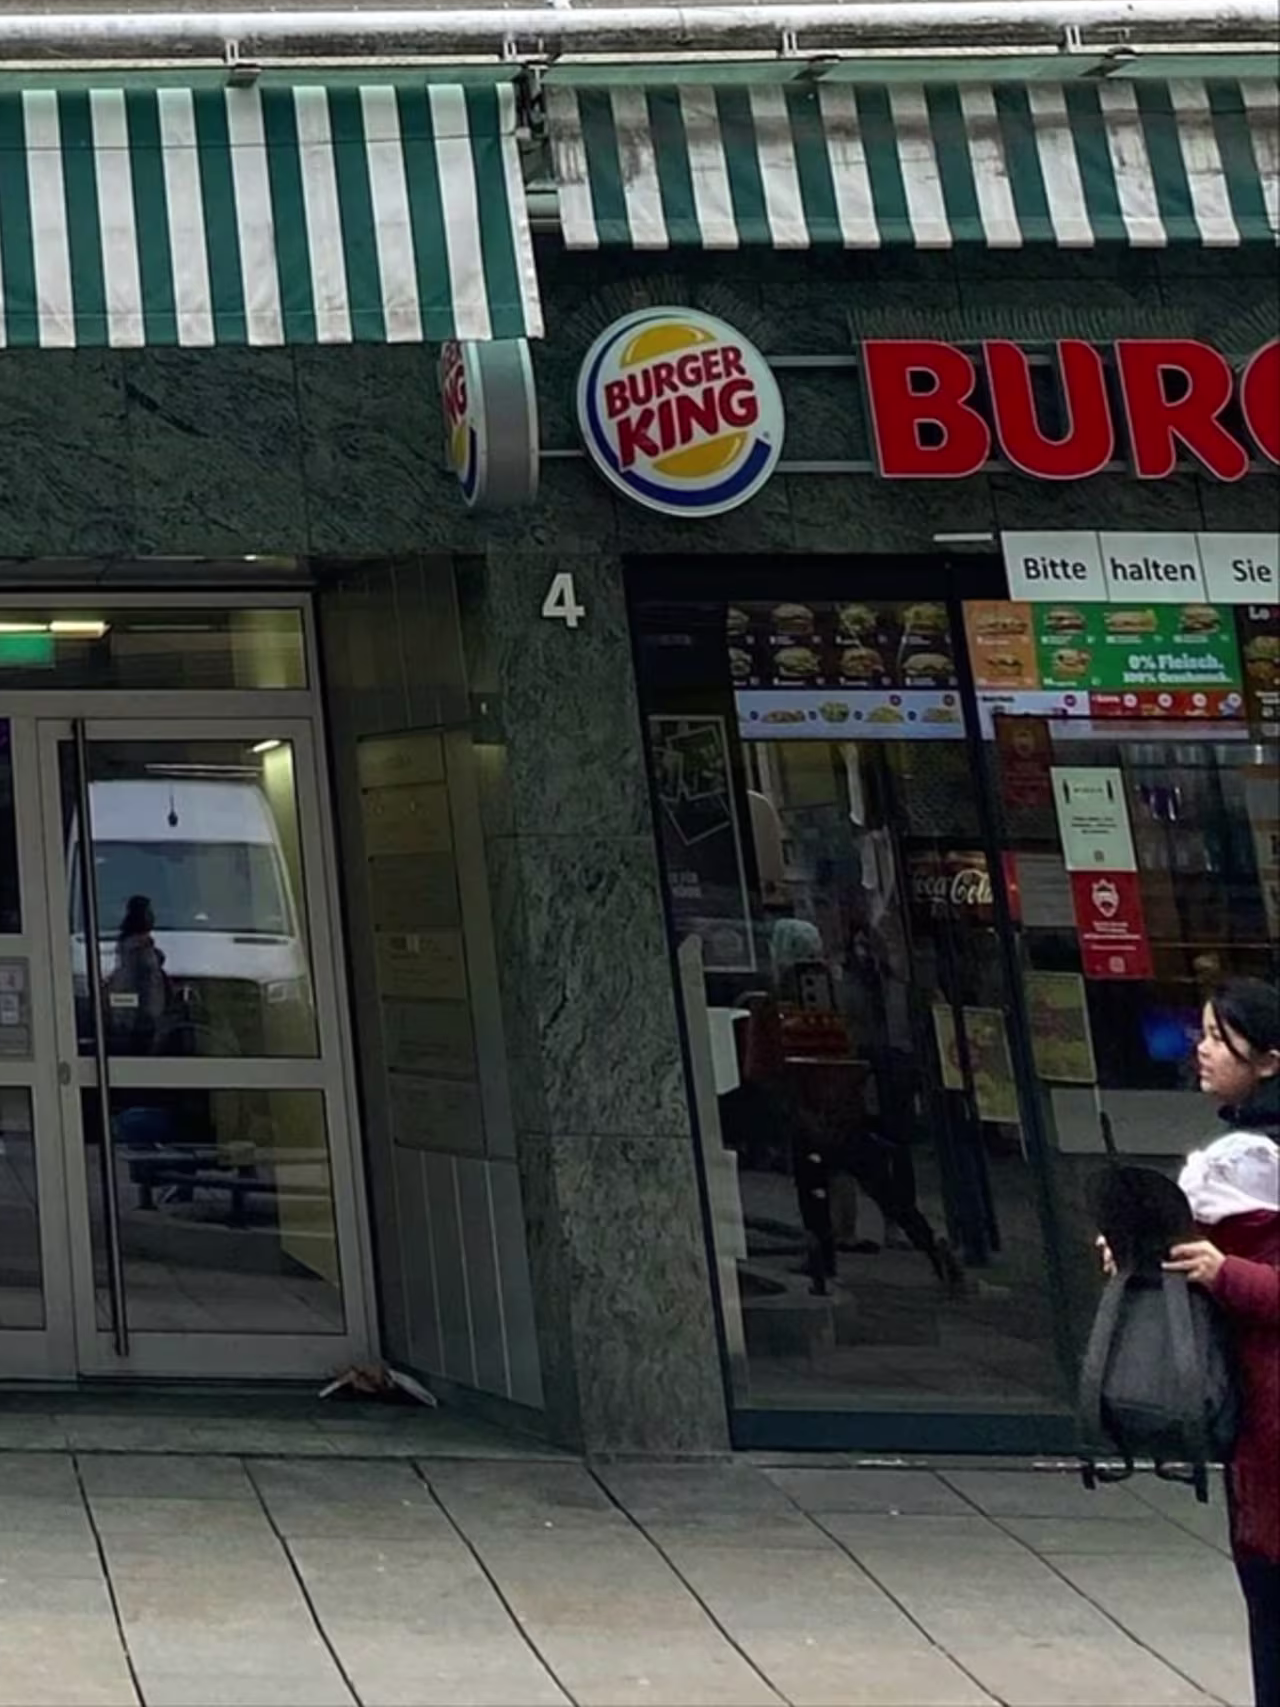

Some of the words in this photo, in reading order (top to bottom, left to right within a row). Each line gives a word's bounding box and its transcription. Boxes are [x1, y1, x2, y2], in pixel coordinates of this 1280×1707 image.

[603, 345, 747, 419] BURGER
[615, 378, 759, 468] KING
[541, 572, 586, 628] 4
[1022, 556, 1087, 581] Bitte
[1109, 556, 1197, 582] halten
[1231, 558, 1272, 583] Sie
